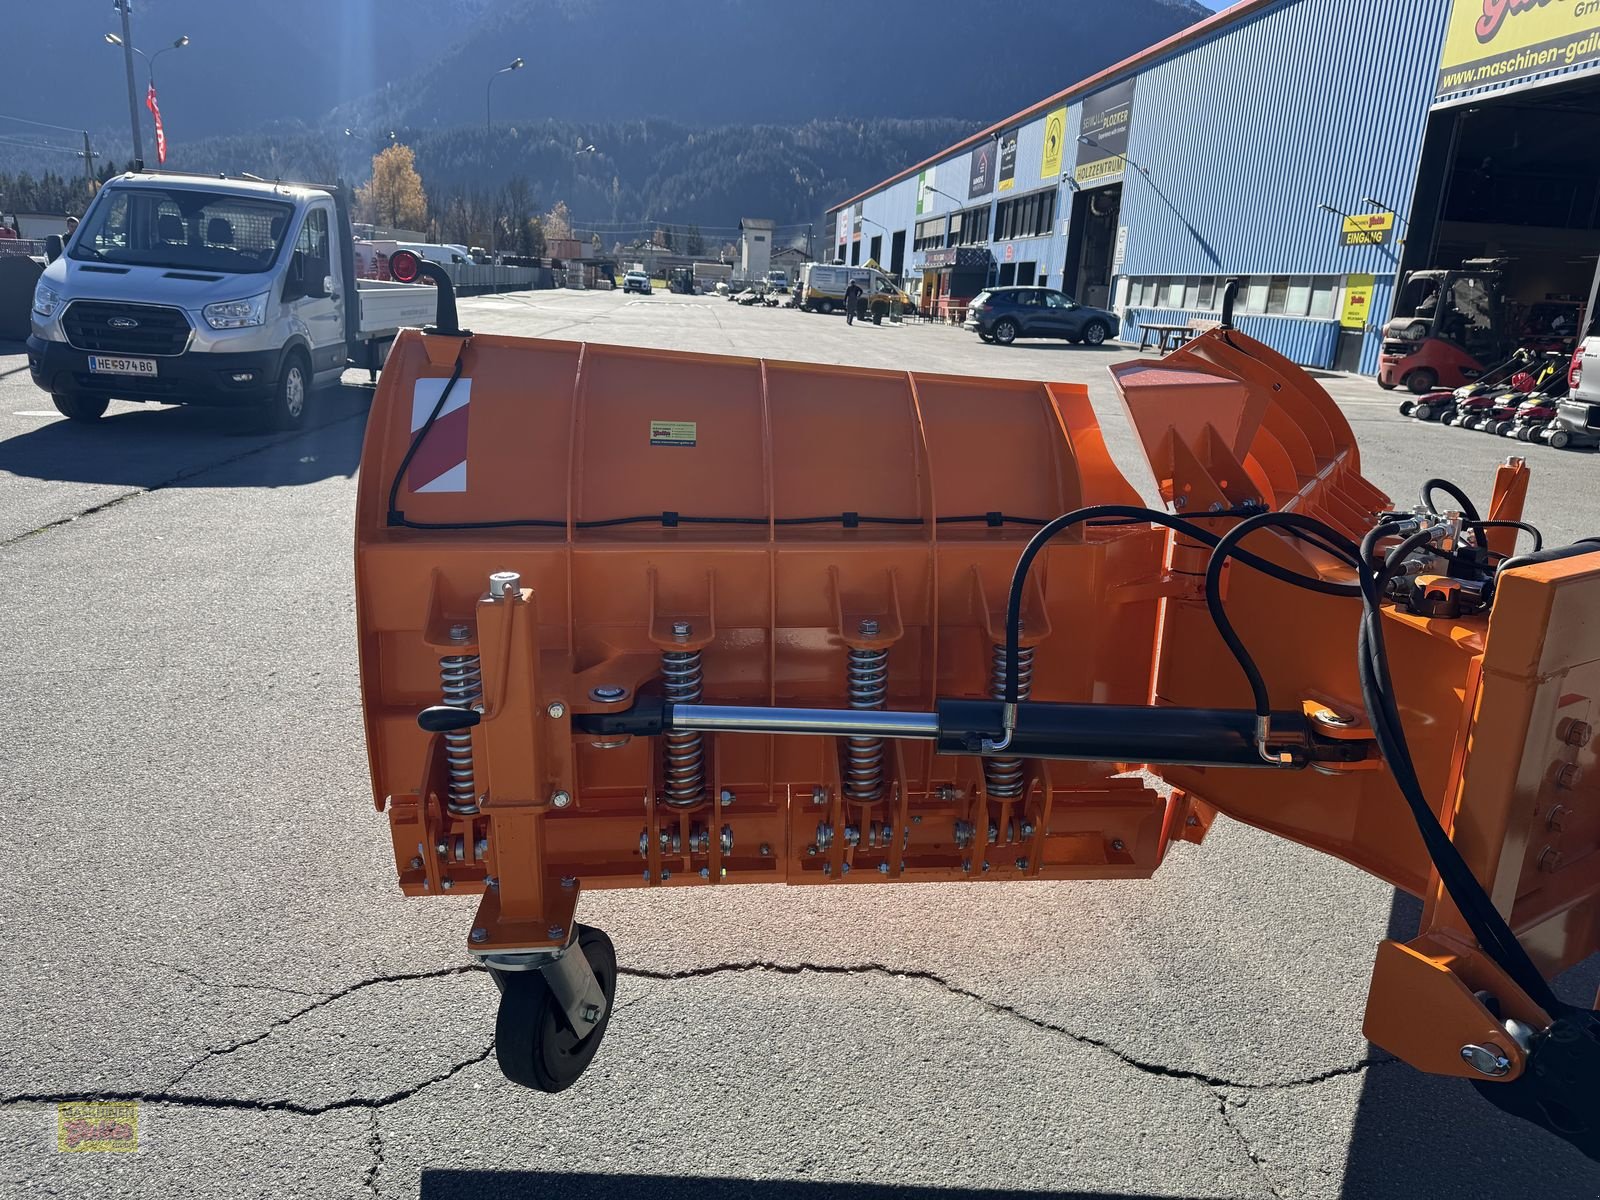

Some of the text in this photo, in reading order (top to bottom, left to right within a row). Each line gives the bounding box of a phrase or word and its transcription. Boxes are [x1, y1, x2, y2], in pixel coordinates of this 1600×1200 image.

[1077, 158, 1123, 180] HOLZZENTRUM
[1346, 231, 1383, 245] EINGANG
[97, 358, 153, 373] HE 974 BG
